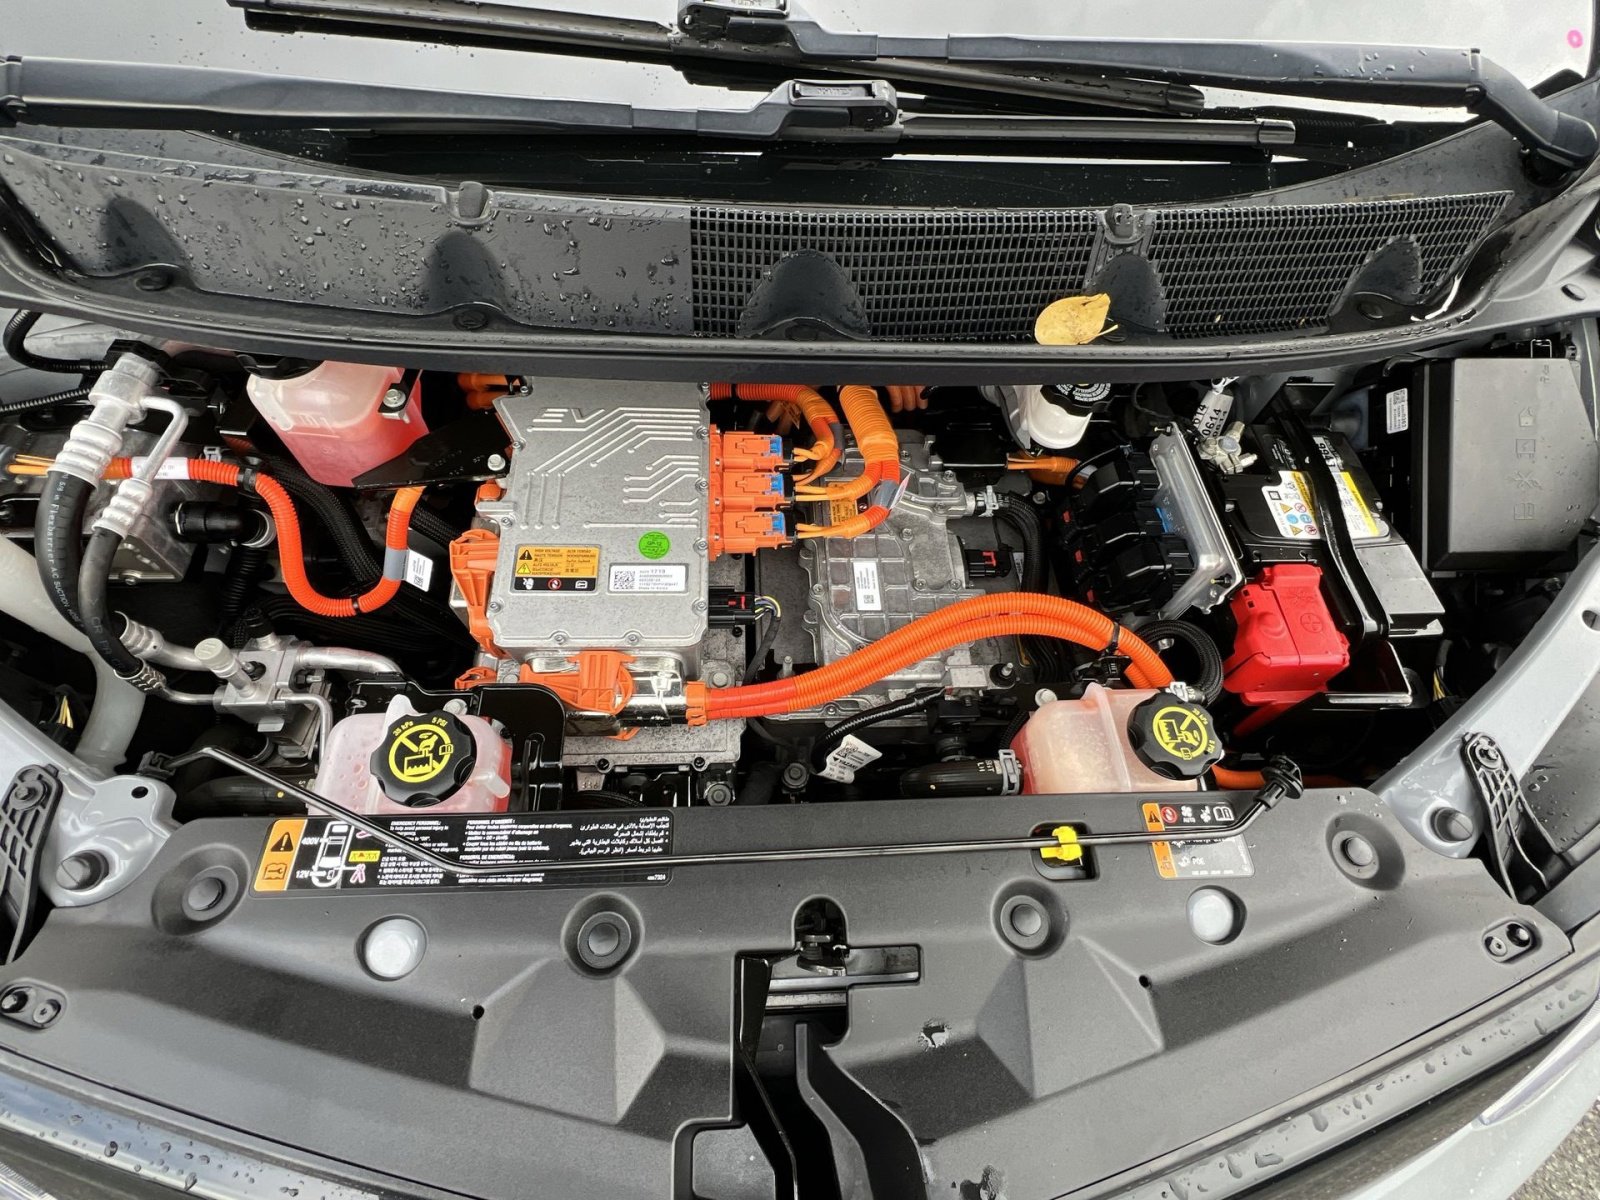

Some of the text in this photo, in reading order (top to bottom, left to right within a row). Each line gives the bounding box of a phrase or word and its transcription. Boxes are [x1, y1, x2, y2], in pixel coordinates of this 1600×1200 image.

[1202, 408, 1222, 436] 0614
[46, 503, 60, 565] Flexbarrier
[53, 581, 70, 607] SUCTION
[301, 837, 320, 845] 400V
[296, 870, 310, 878] 12V
